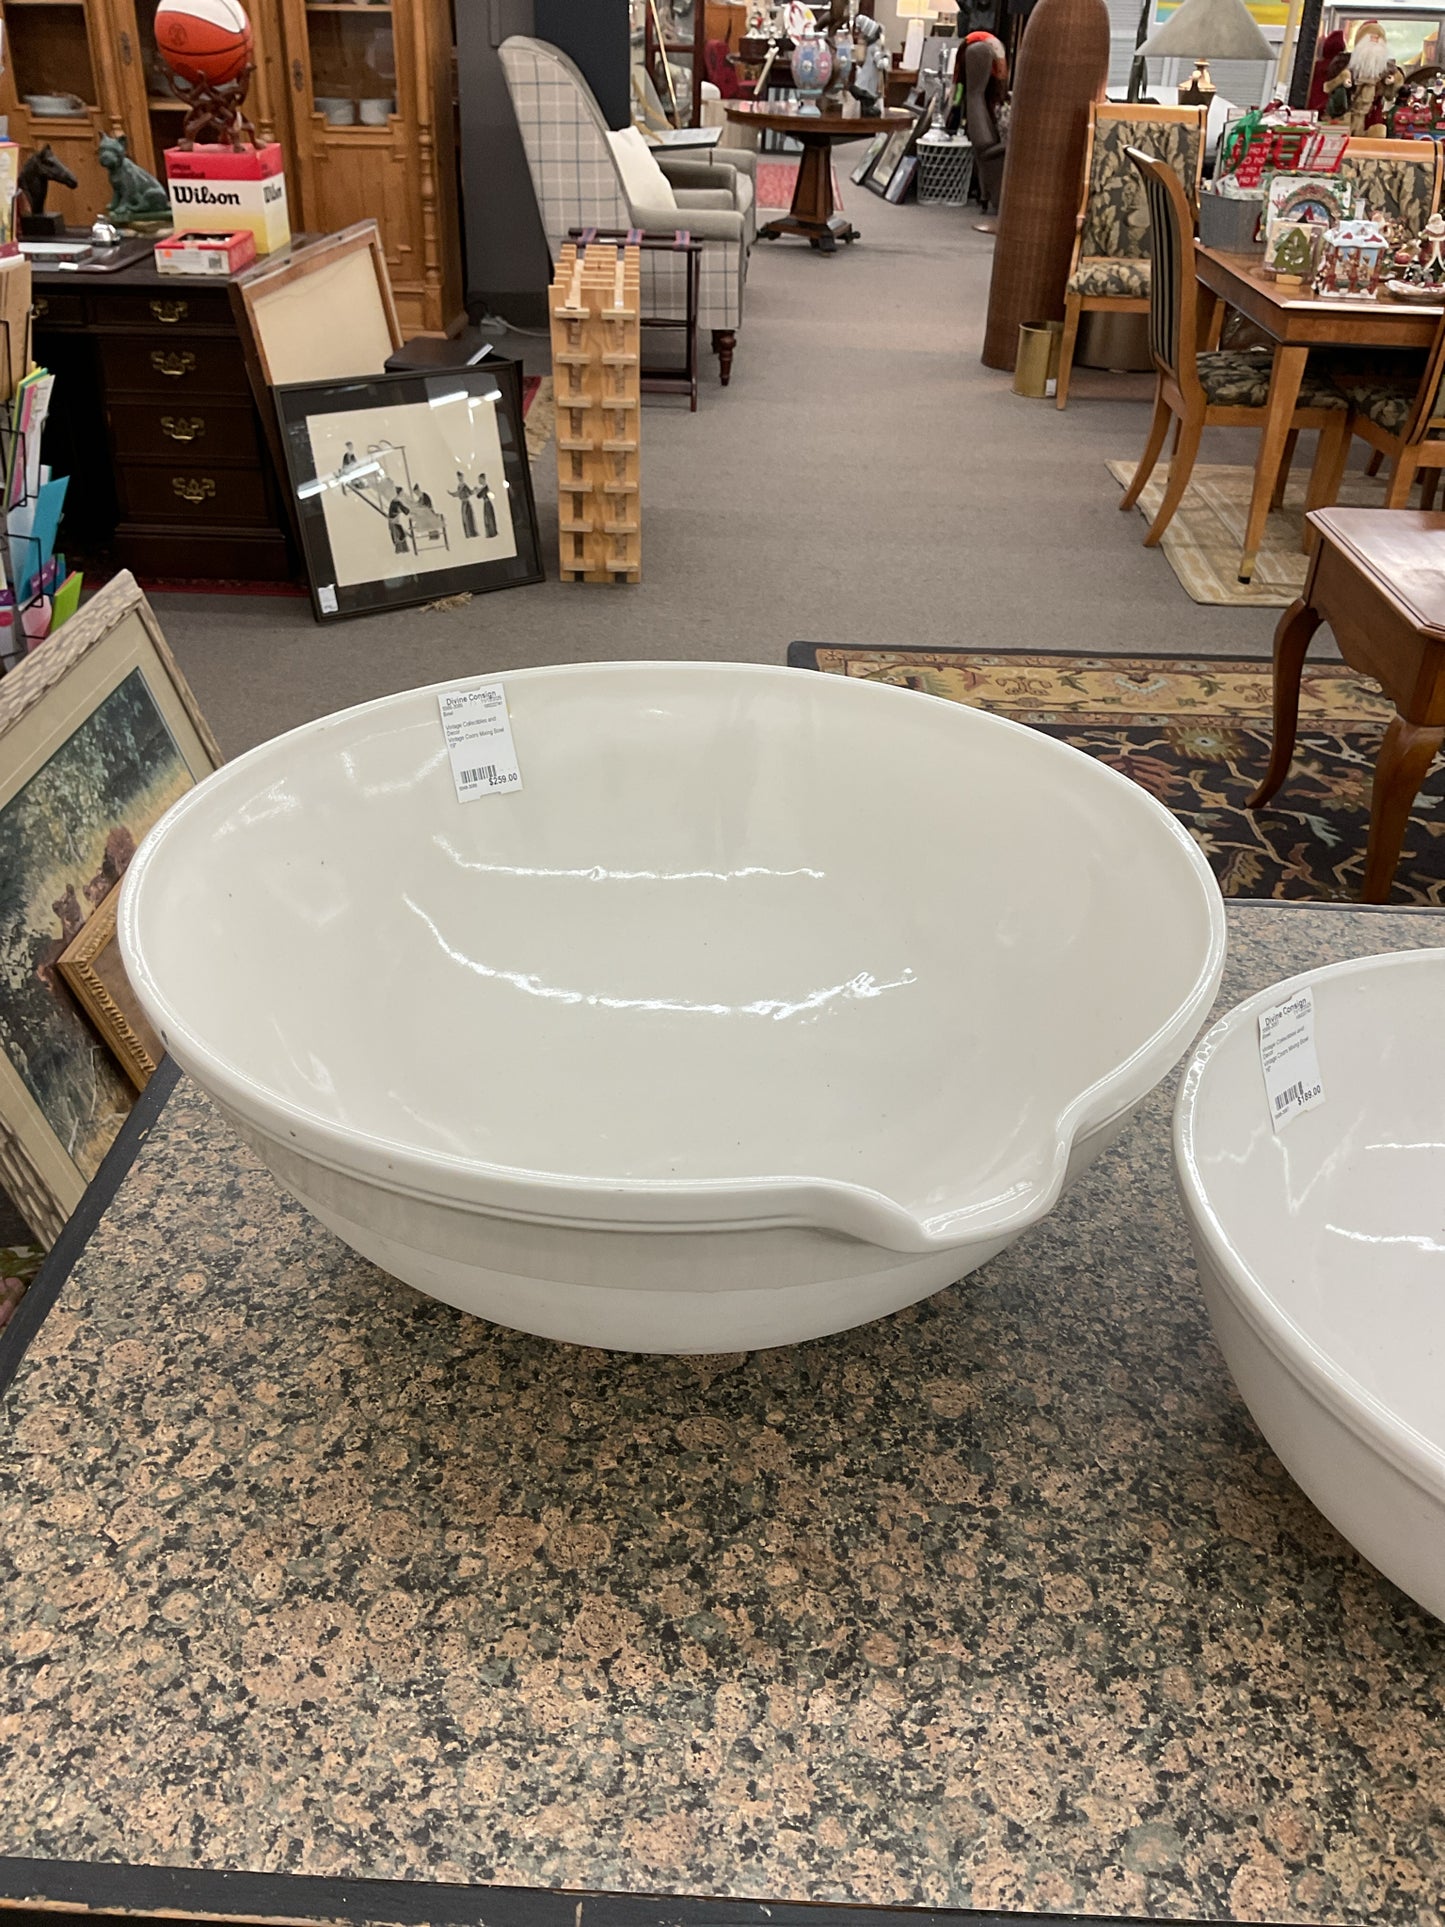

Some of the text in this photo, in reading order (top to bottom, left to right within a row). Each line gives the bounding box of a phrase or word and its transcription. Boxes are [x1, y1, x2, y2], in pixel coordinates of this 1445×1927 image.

[173, 185, 241, 205] Wilson
[446, 696, 468, 706] Divine
[468, 691, 496, 701] Consign
[489, 772, 518, 786] $259.00
[1265, 1012, 1282, 1026] Divine
[1282, 998, 1306, 1015] Consign
